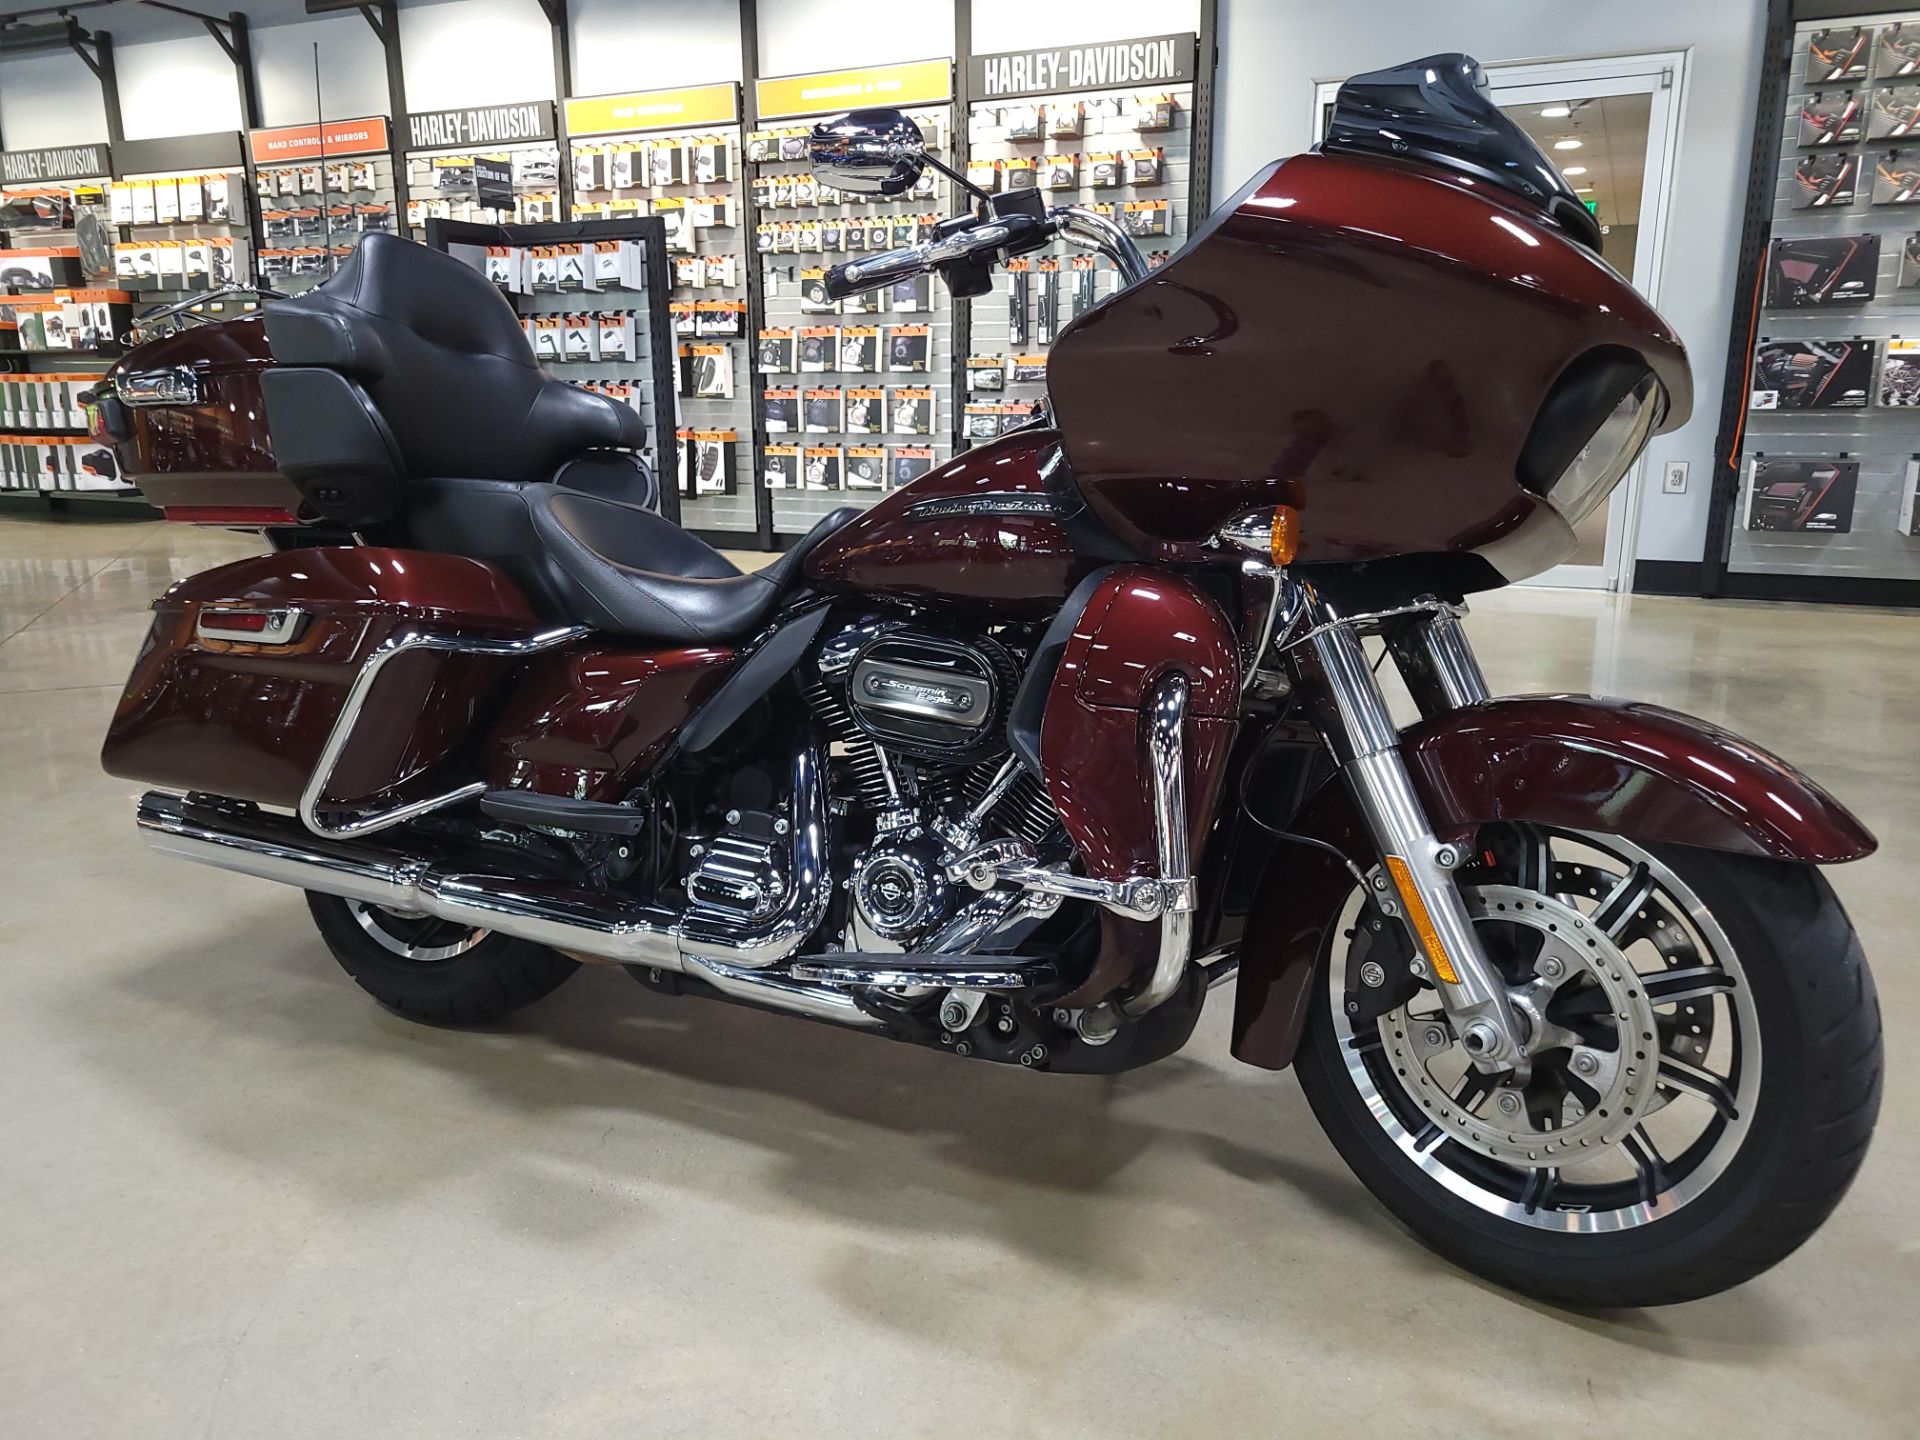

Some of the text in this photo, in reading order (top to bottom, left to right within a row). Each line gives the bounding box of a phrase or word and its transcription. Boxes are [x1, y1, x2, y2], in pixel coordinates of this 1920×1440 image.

[984, 39, 1175, 95] HARLEY-DAVIDSON
[268, 141, 287, 150] HAND
[334, 131, 369, 143] MIRRORS
[409, 105, 541, 147] HARLEY-DAVIDSON
[2, 147, 100, 180] HARLEY-DAVIDSON
[915, 692, 954, 705] Eagle
